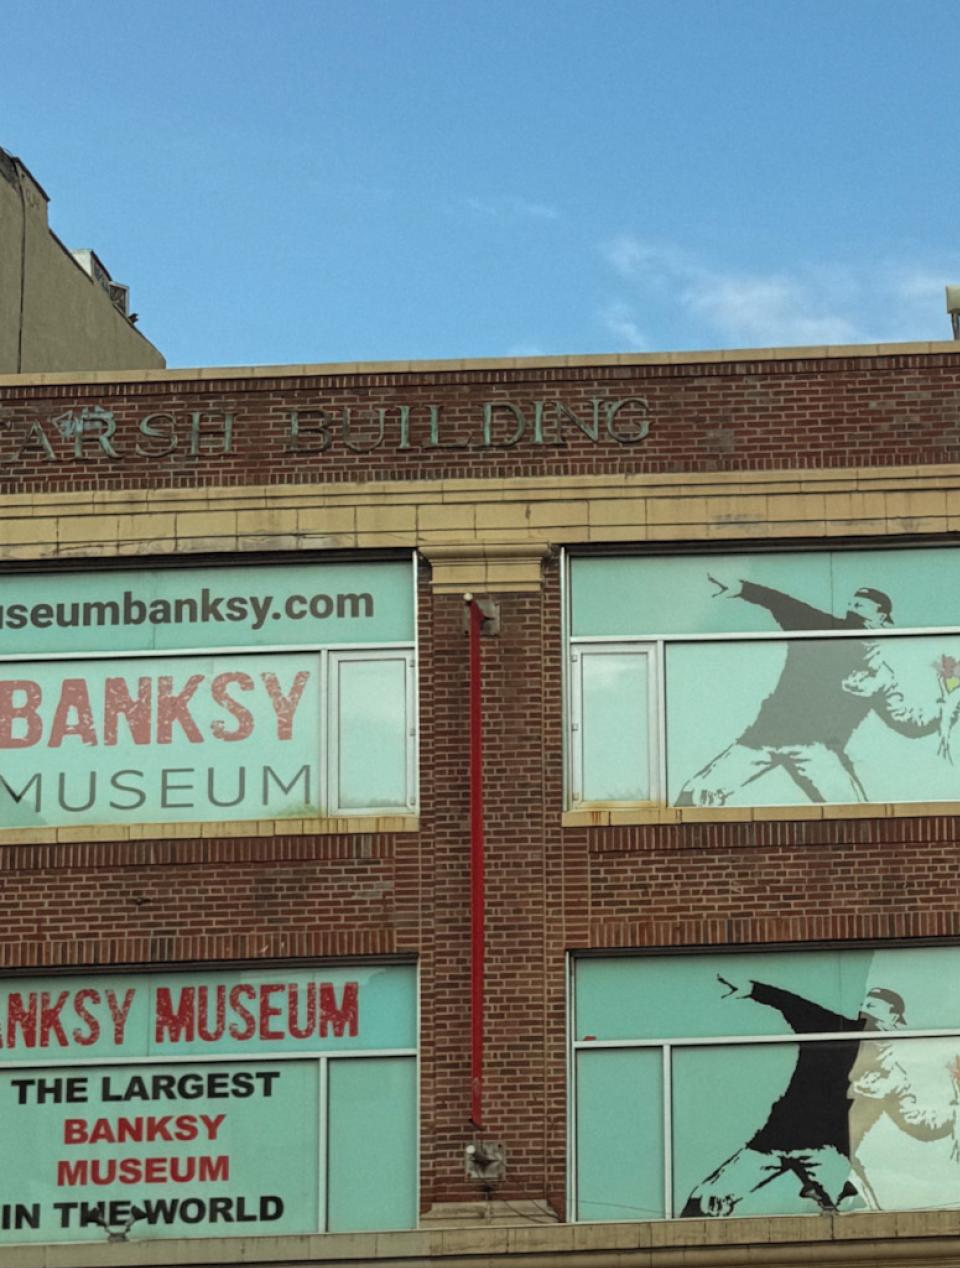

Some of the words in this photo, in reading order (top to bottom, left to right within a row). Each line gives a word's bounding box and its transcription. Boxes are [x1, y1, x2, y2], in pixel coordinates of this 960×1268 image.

[0, 410, 241, 462] ARSH
[287, 396, 652, 454] BUILDING
[0, 671, 310, 748] BANKSY
[0, 764, 311, 813] MUSEUM
[0, 988, 135, 1049] NKSY
[155, 981, 359, 1044] MUSEUM
[11, 1077, 88, 1104] THE
[102, 1071, 280, 1101] LARGEST
[64, 1113, 225, 1144] BANKSY
[57, 1156, 229, 1186] MUSEUM
[3, 1204, 40, 1230] IN
[54, 1200, 131, 1228] THE
[142, 1195, 284, 1225] WORLD
